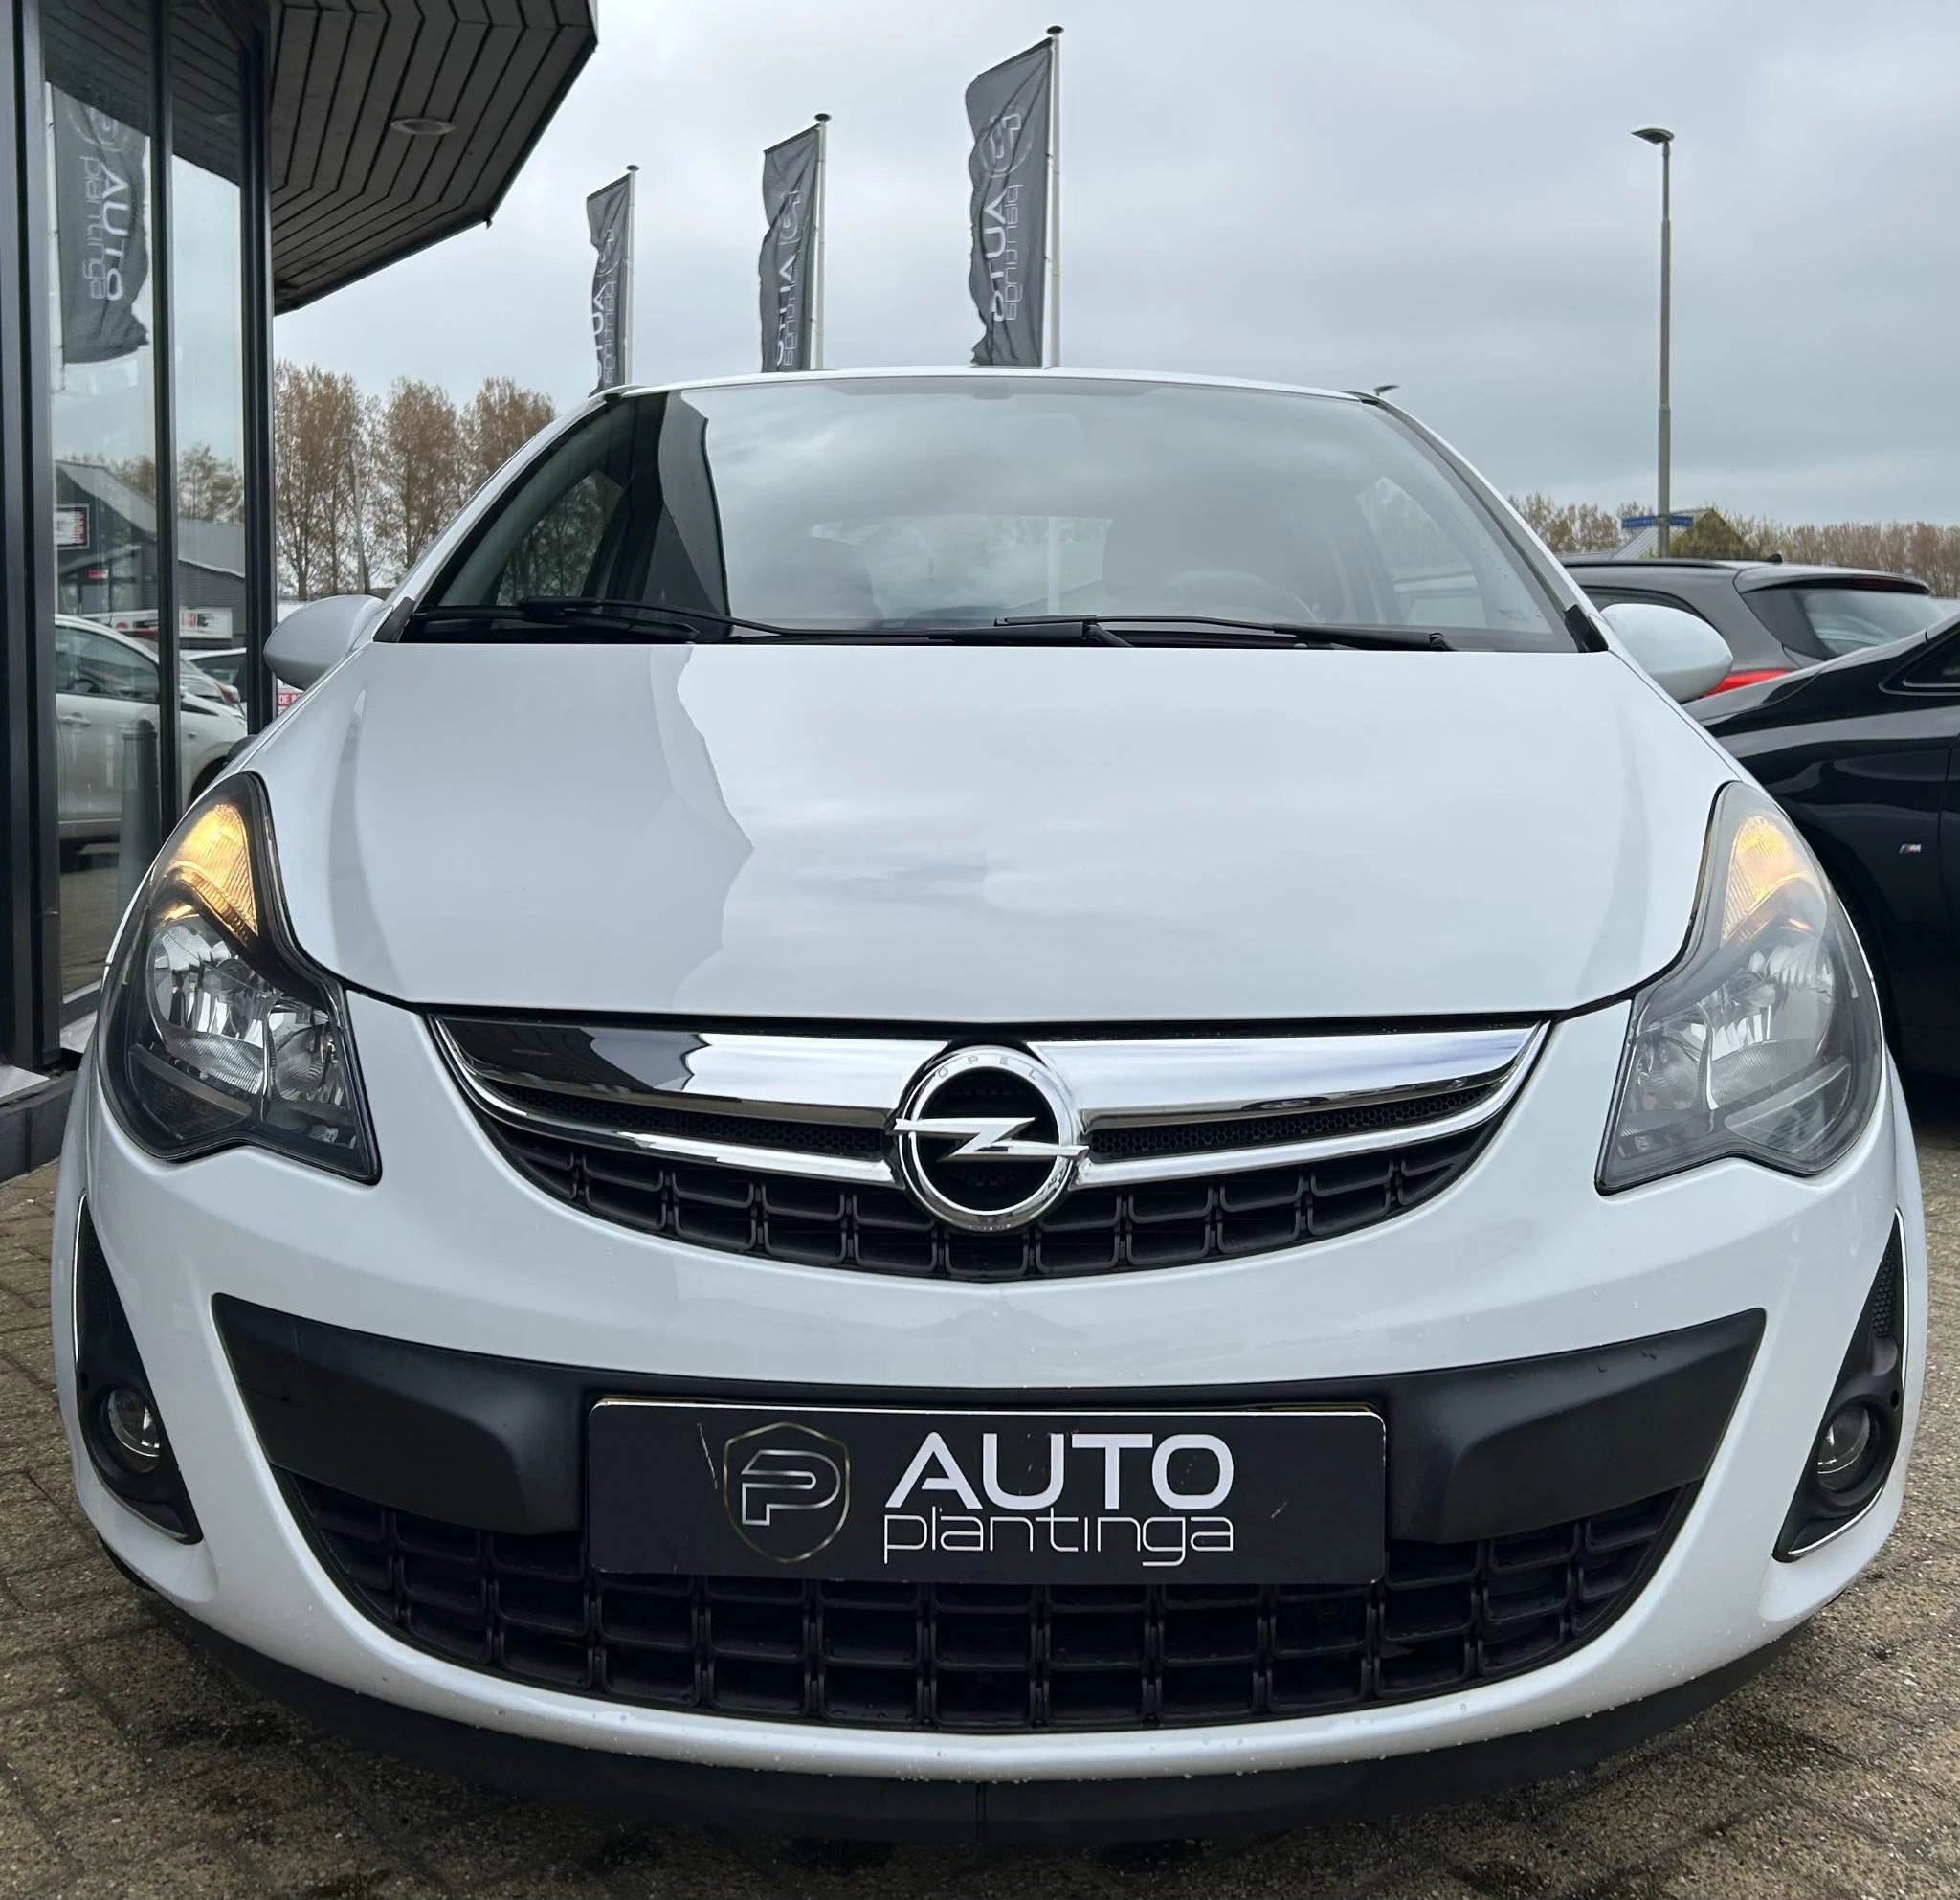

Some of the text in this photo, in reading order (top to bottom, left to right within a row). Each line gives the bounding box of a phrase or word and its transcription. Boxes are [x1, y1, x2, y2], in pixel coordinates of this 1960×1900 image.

[100, 161, 129, 302] AUTO
[938, 1056, 1037, 1080] OPEL
[884, 1431, 1235, 1511] AUTO
[884, 1506, 1235, 1568] plantinga
